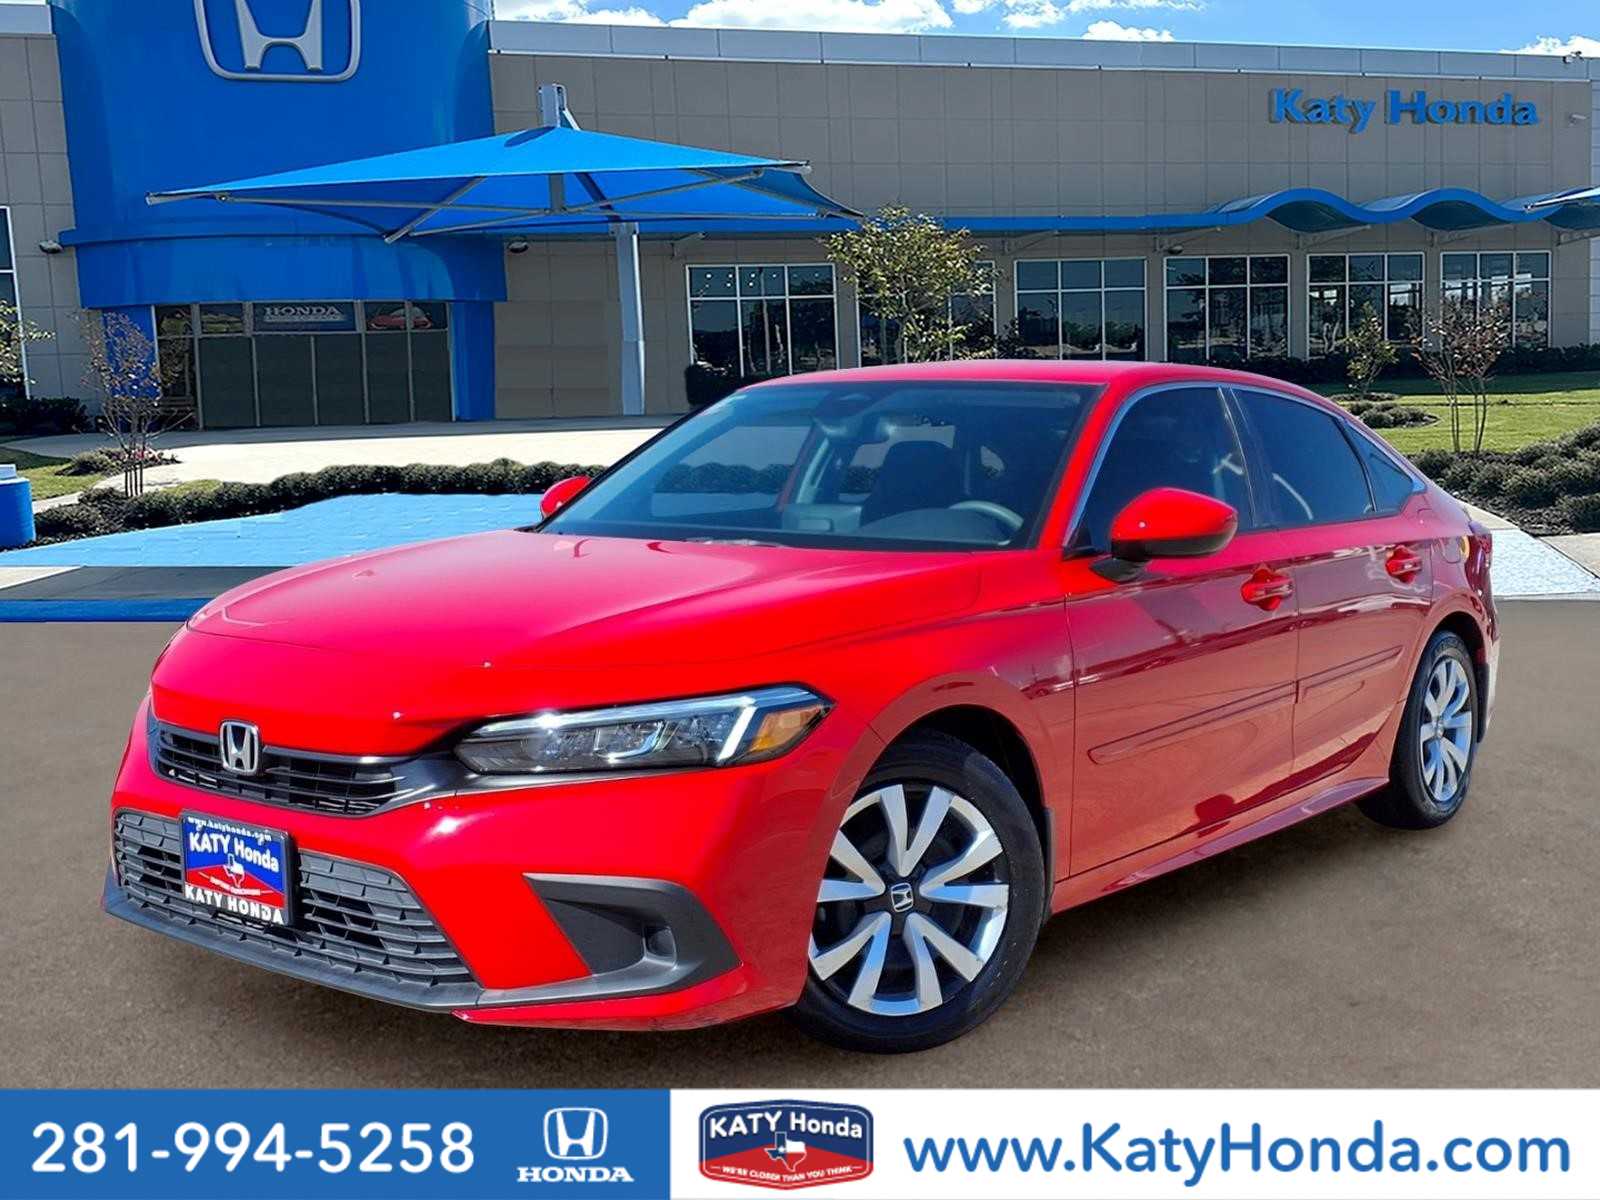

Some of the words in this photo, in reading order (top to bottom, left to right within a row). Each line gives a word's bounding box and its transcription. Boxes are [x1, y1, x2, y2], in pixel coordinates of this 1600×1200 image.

[1270, 88, 1376, 133] Katy
[1385, 89, 1539, 126] Honda
[264, 305, 342, 316] HONDA
[188, 831, 231, 854] KATY
[233, 837, 280, 873] Honda
[184, 884, 223, 908] KATY
[227, 896, 285, 925] HONDA
